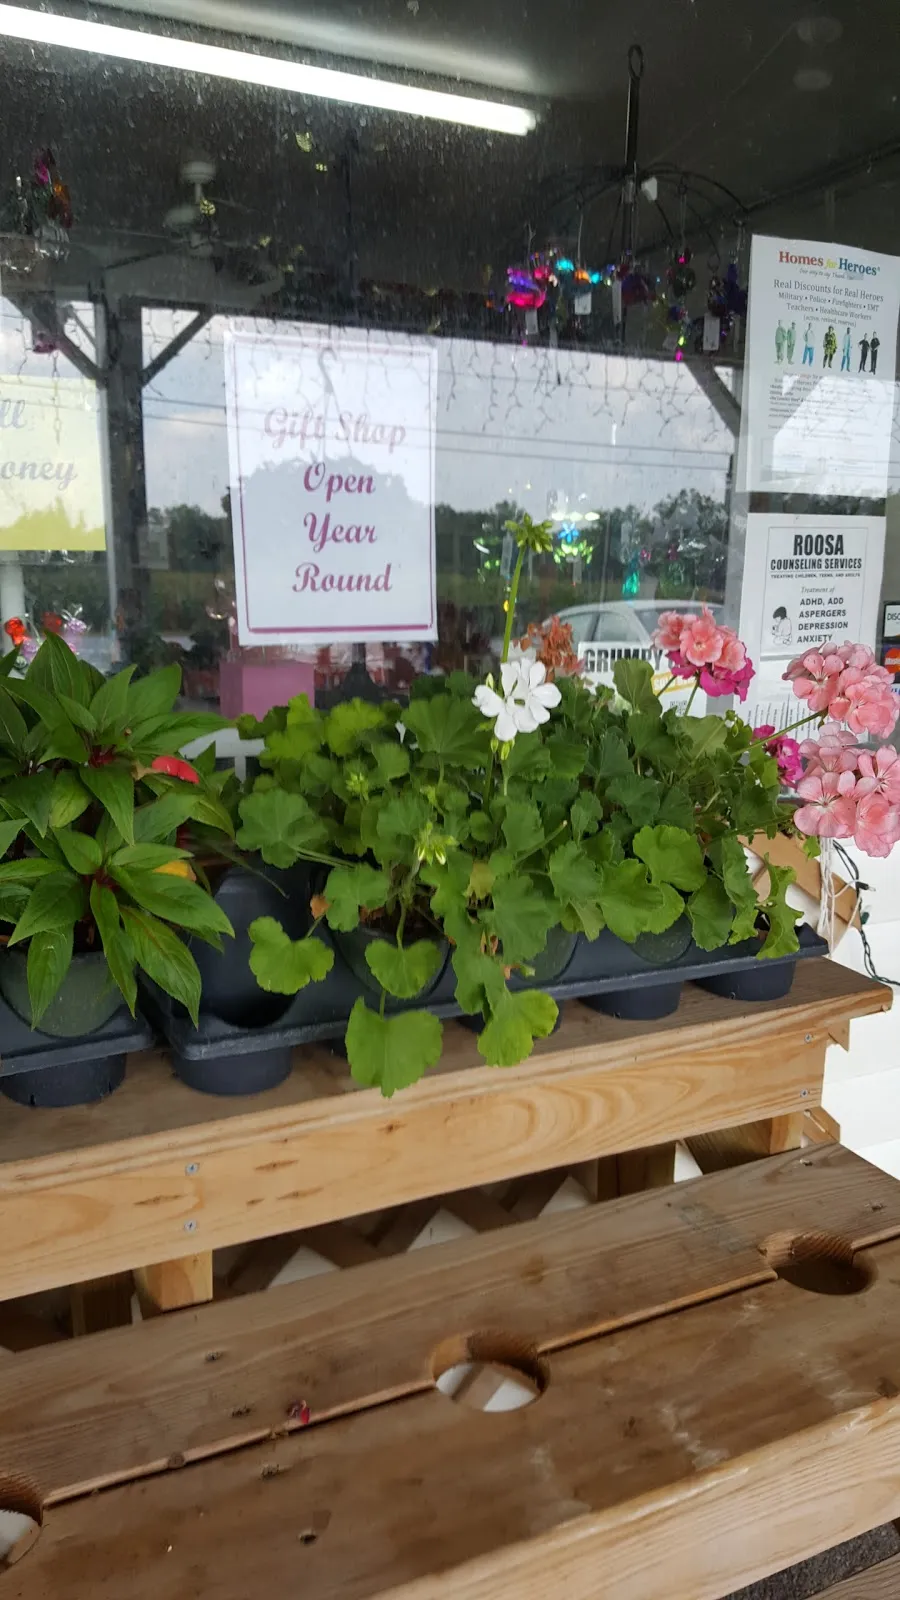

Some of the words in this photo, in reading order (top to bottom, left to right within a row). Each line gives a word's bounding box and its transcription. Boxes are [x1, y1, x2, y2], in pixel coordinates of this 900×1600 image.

[779, 250, 824, 267] Homes
[773, 279, 792, 288] Real
[794, 280, 832, 294] Discounts
[833, 285, 843, 295] for
[844, 287, 859, 298] Real
[860, 290, 884, 302] Heroes
[778, 292, 804, 301] Military
[809, 295, 827, 304] Police
[831, 298, 862, 310] Firefighters
[867, 303, 880, 312] EMT
[786, 303, 814, 312] Teachers
[819, 306, 848, 317] Healthcare
[849, 310, 872, 320] Workers
[263, 407, 325, 449] Gift
[334, 411, 406, 454] Shop
[303, 461, 376, 503] Open
[303, 512, 377, 553] Year
[793, 534, 845, 556] ROOSA
[770, 559, 822, 570] COUNSELING
[824, 558, 862, 569] SERVICES
[291, 562, 392, 593] Round
[800, 598, 825, 606] ADHD,
[827, 597, 844, 605] ADD
[798, 609, 847, 619] ASPERGERS
[798, 621, 849, 631] DEPRESSION
[796, 634, 833, 643] ANXIETY
